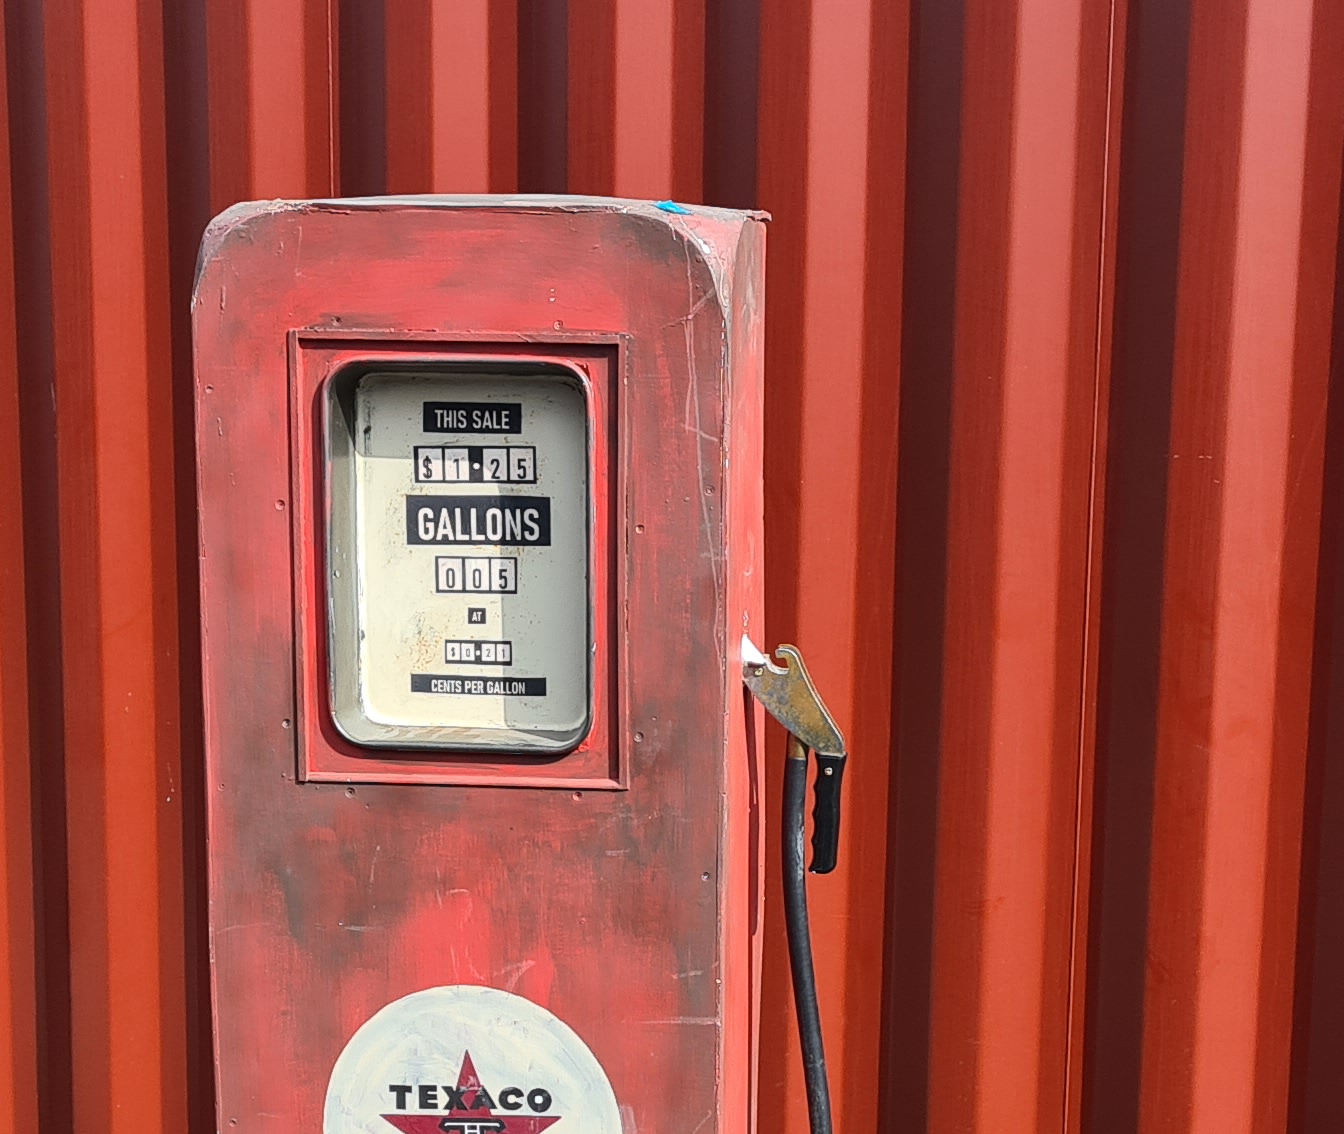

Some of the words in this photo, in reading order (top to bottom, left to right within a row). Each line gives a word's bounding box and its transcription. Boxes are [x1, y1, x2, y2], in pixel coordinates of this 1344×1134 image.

[434, 410, 467, 429] THIS
[472, 410, 510, 430] SALE
[417, 507, 540, 542] GALLONS
[445, 568, 508, 589] 005
[471, 611, 482, 622] AT
[431, 679, 462, 692] CENTS
[464, 680, 484, 694] PER
[486, 681, 526, 695] GALLON
[389, 1084, 552, 1113] TEXACO
